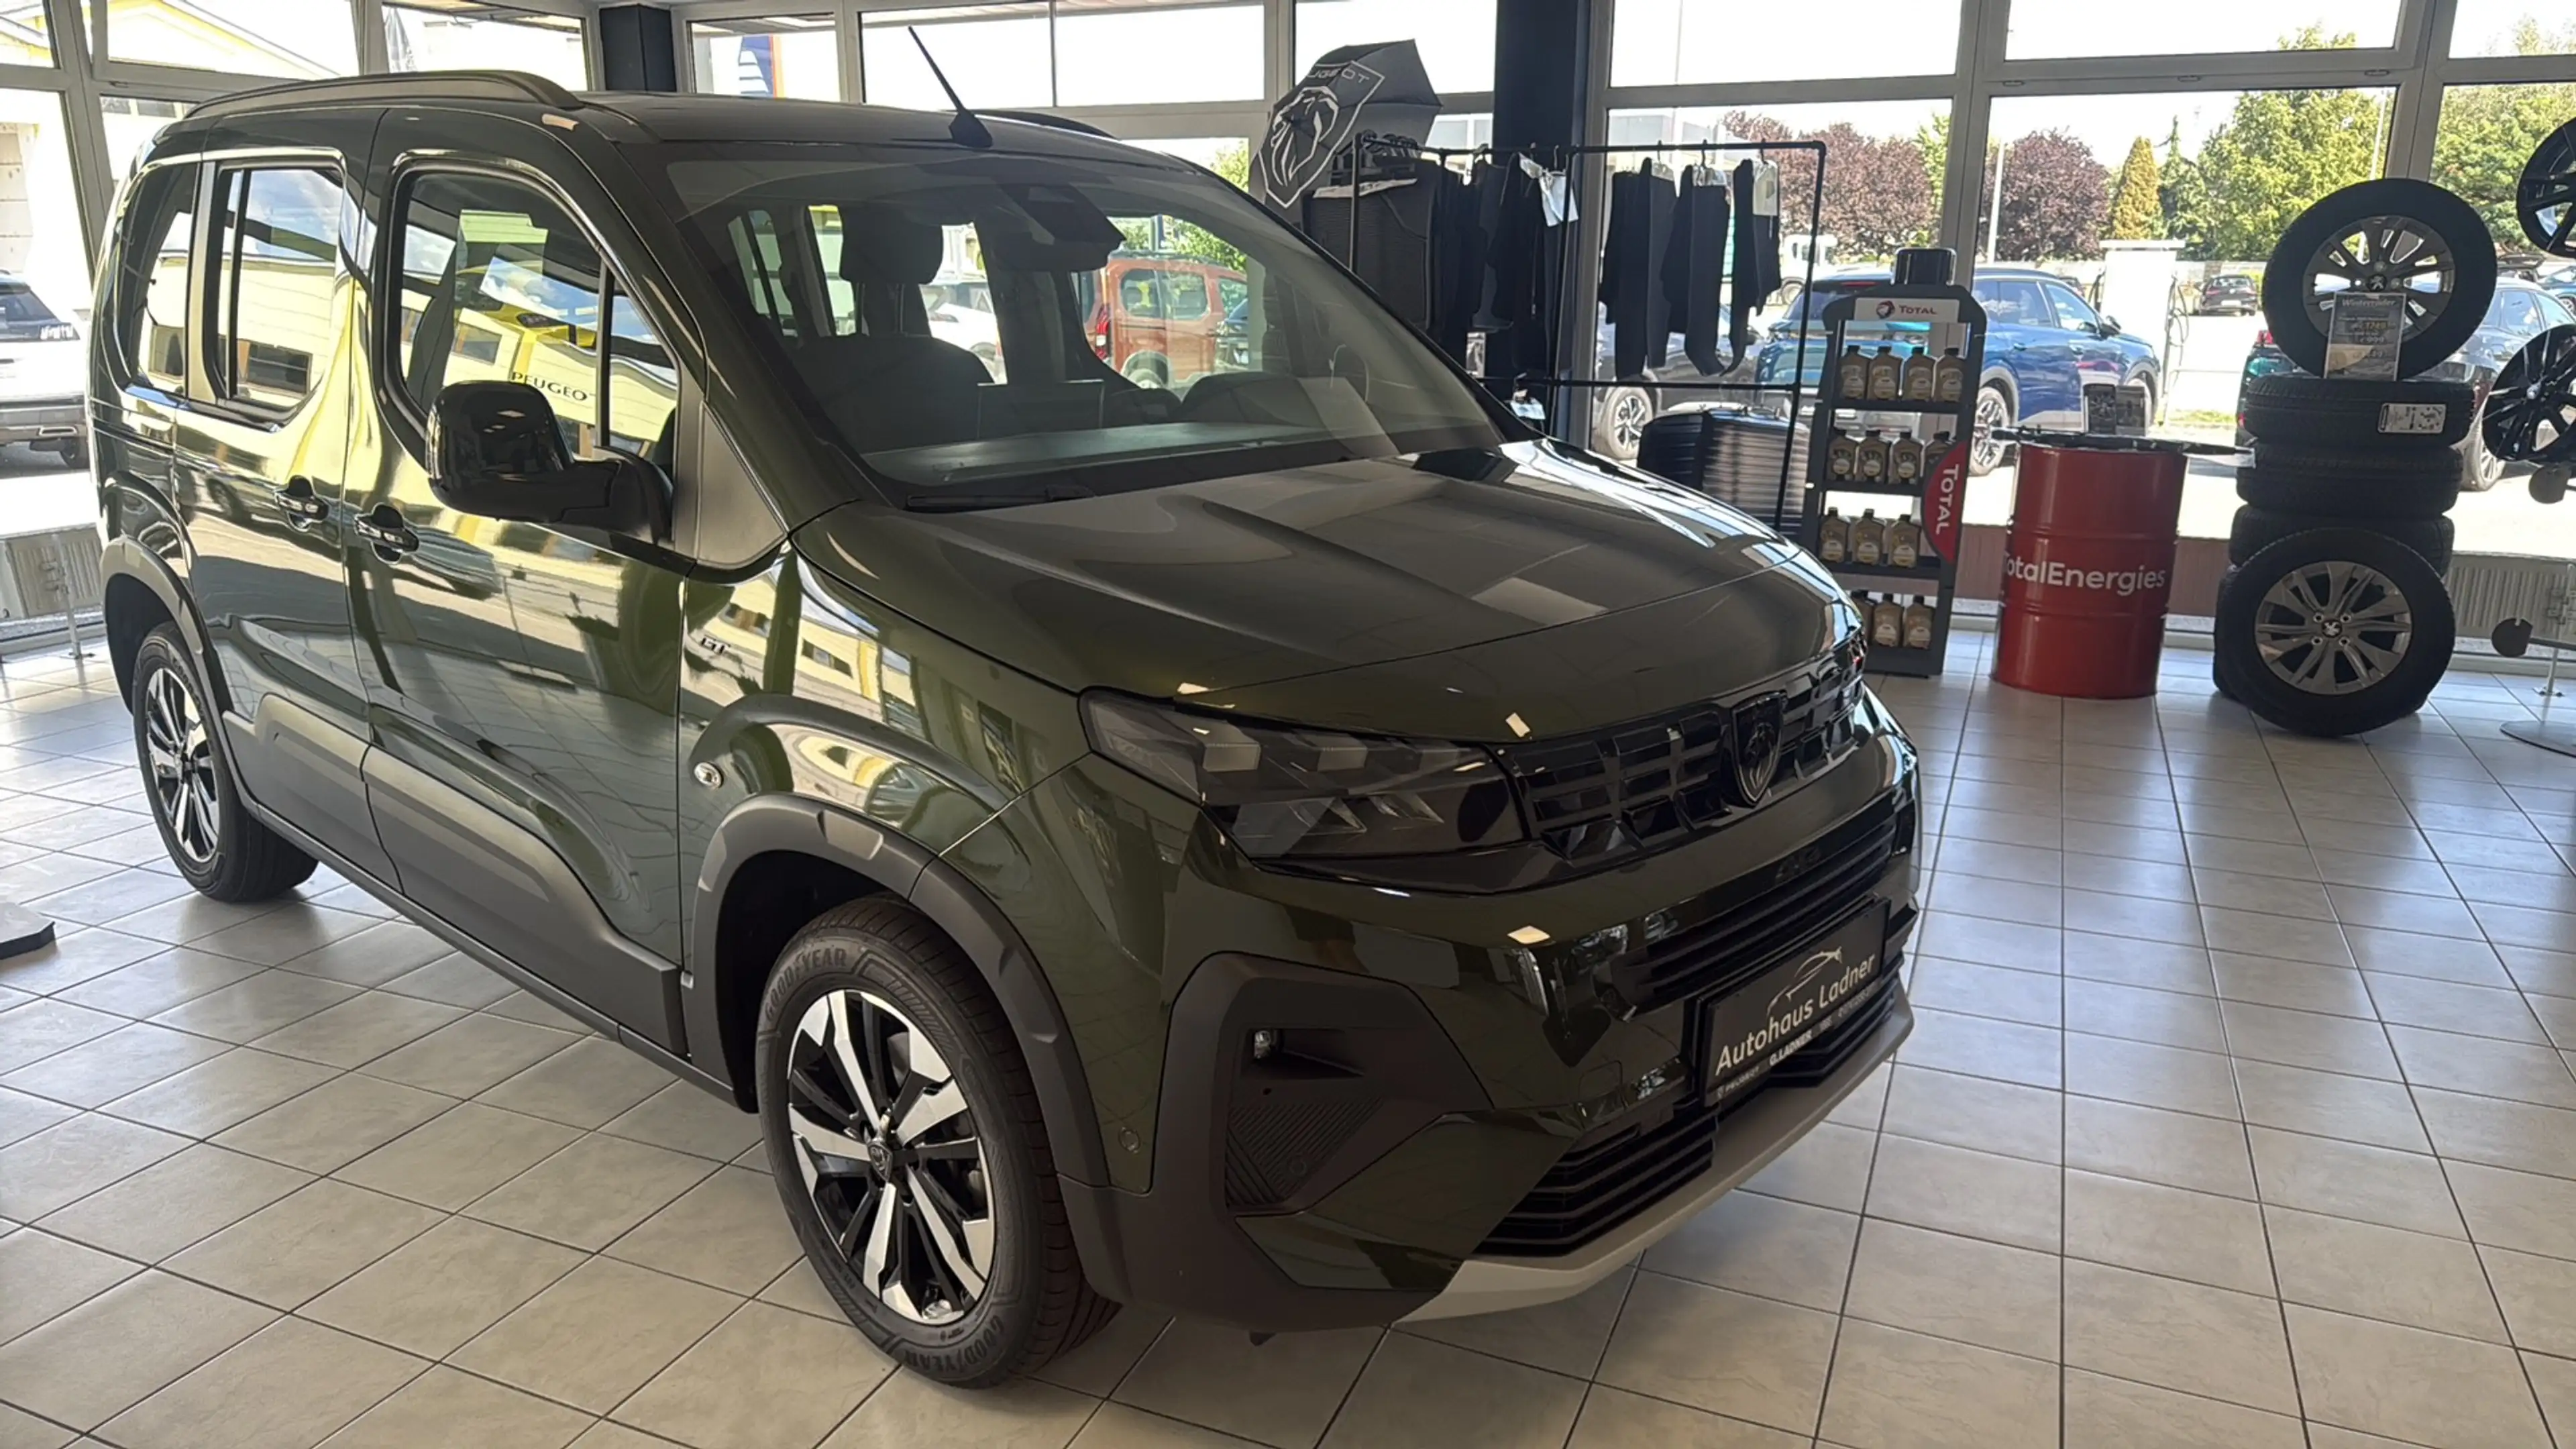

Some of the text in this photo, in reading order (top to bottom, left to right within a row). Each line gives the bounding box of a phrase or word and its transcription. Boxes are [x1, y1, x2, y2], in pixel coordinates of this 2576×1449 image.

[1899, 305, 1937, 315] TOTAL
[512, 372, 596, 401] PEUGEO
[1935, 464, 1960, 535] TOTAL
[765, 948, 847, 1022] GOODYEAR
[1715, 998, 1814, 1076] Autohaus
[1819, 953, 1876, 1008] Ladner
[1769, 1029, 1813, 1067] G.LADNER
